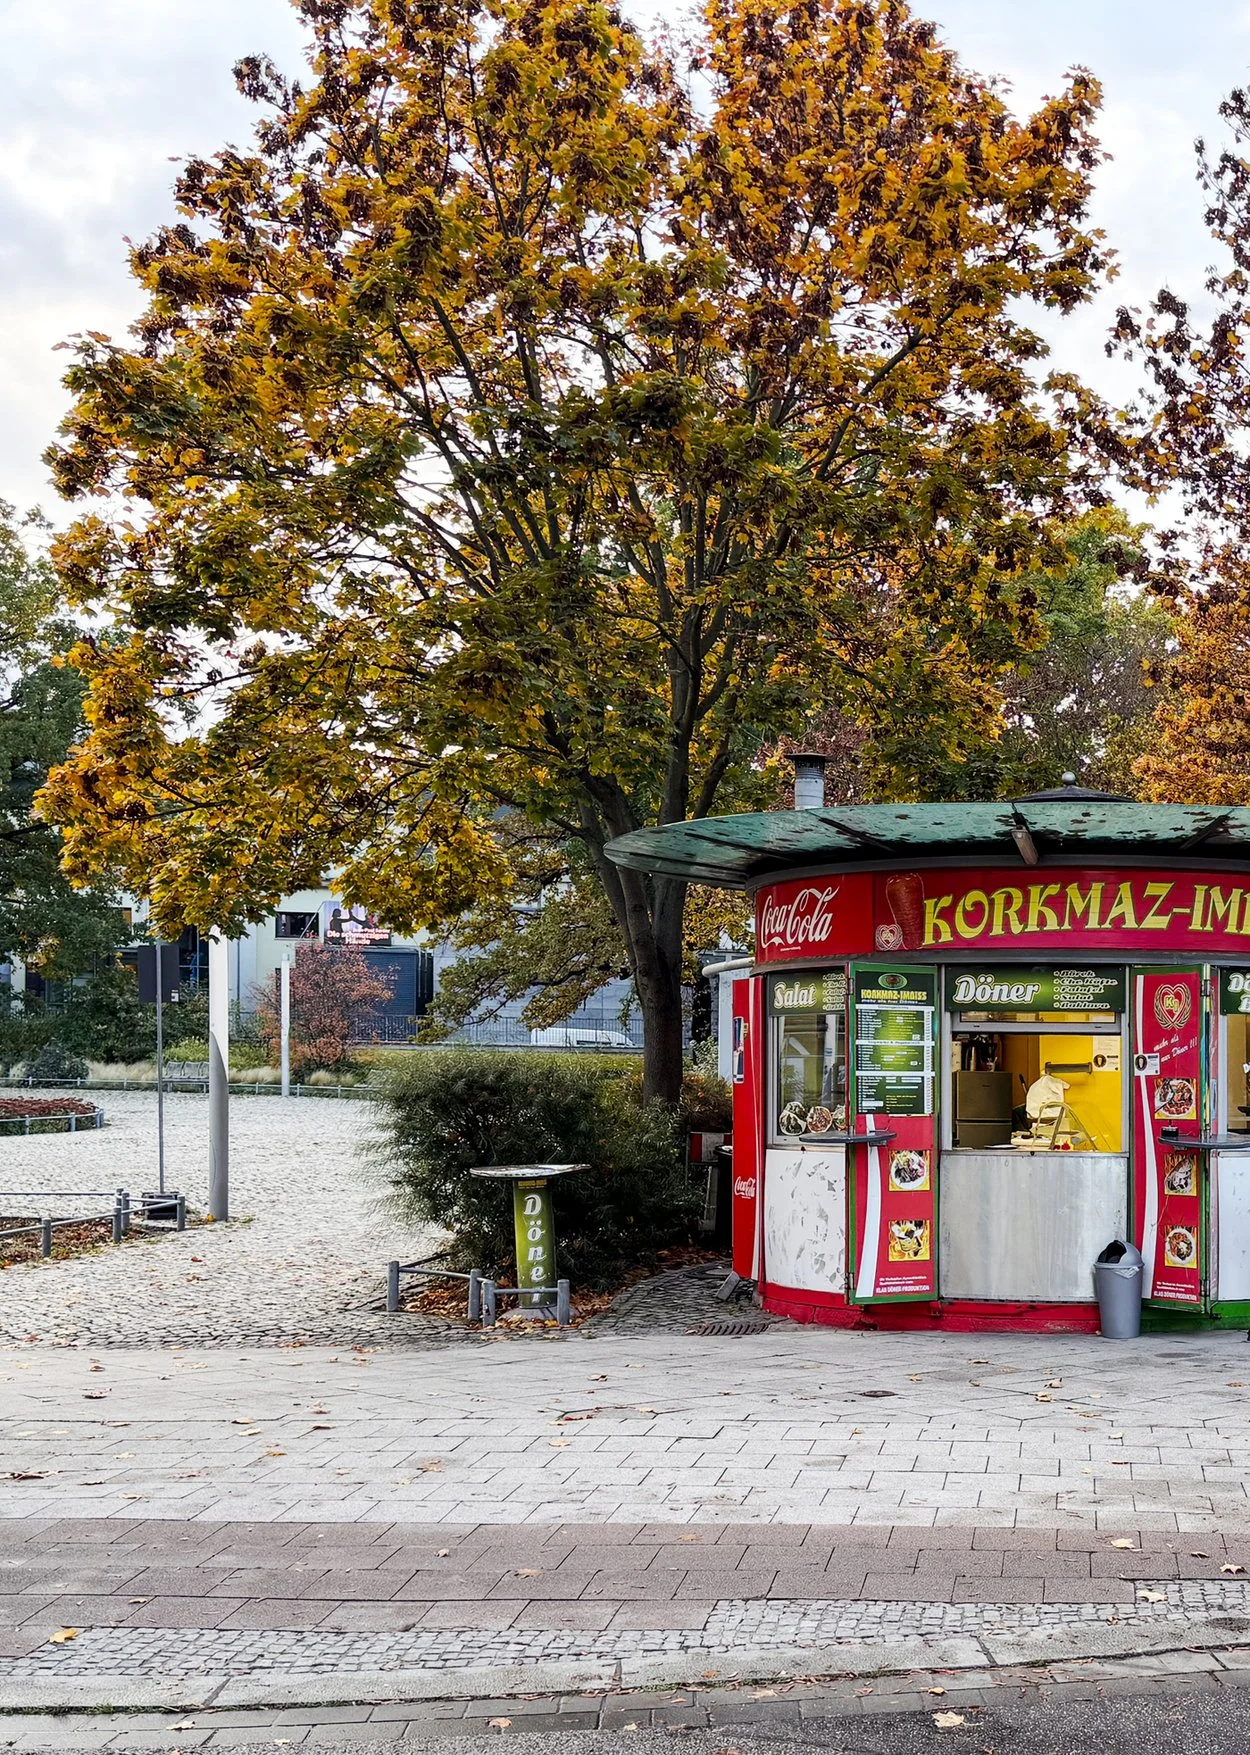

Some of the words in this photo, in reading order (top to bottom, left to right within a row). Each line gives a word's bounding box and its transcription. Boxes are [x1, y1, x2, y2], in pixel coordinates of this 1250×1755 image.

[761, 886, 840, 949] Coca-Cola
[326, 930, 340, 938] Die
[774, 981, 817, 1009] Salat
[953, 974, 1041, 1004] Döner
